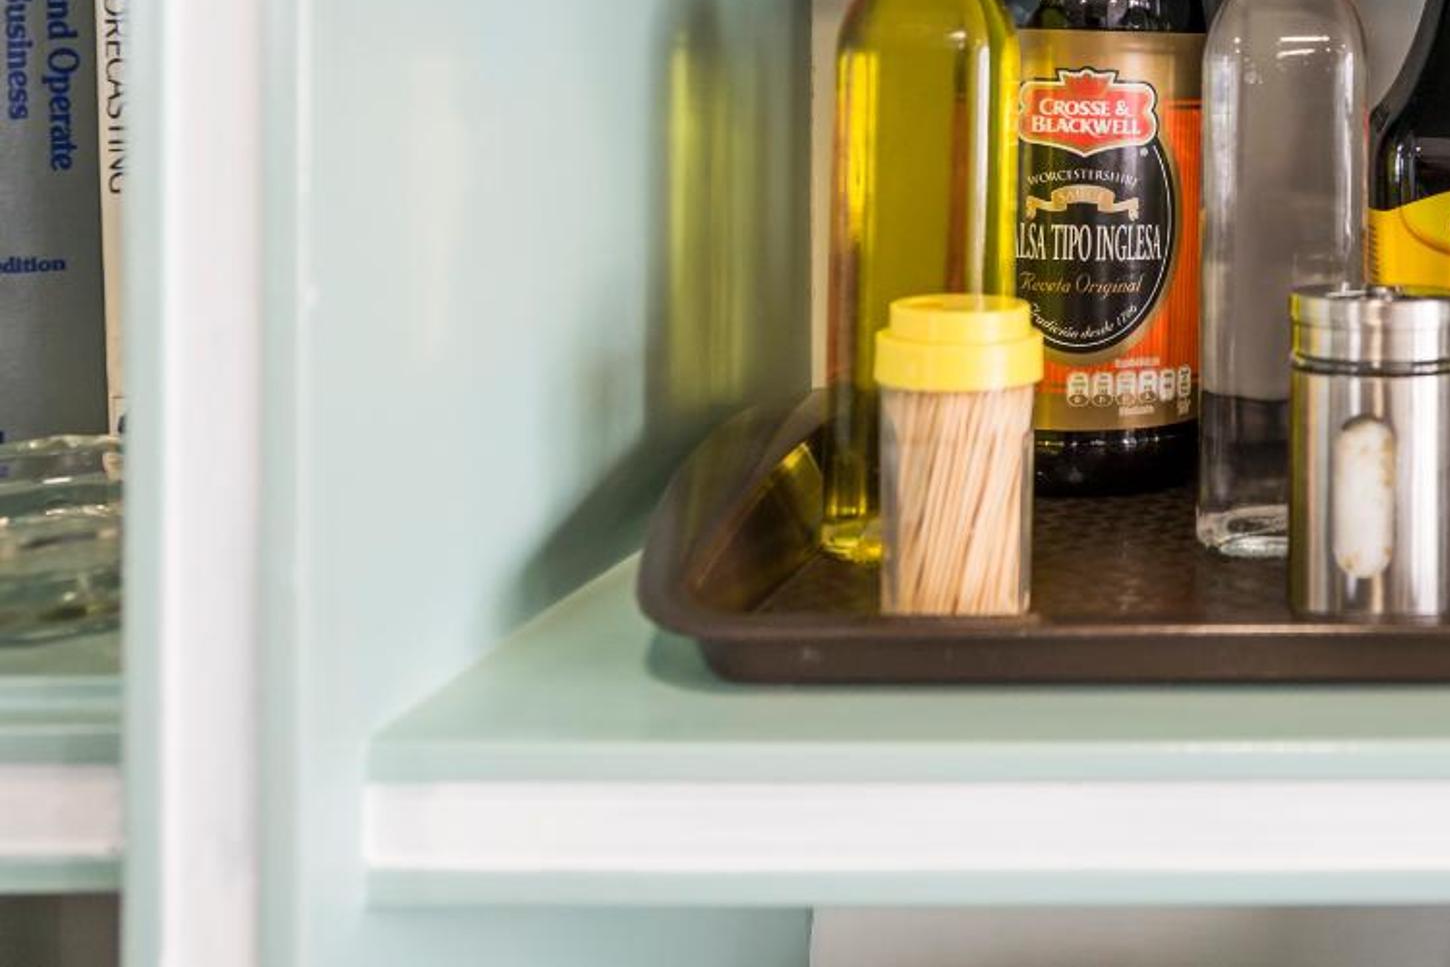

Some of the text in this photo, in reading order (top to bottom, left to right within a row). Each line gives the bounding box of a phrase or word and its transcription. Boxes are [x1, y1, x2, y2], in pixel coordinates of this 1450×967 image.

[42, 47, 81, 171] Operate
[1038, 98, 1131, 116] CROSSE &
[1032, 116, 1141, 135] BLACKWELL
[1051, 224, 1091, 261] TIPO
[1095, 224, 1161, 261] INGLESA
[1019, 271, 1146, 300] Receta Original
